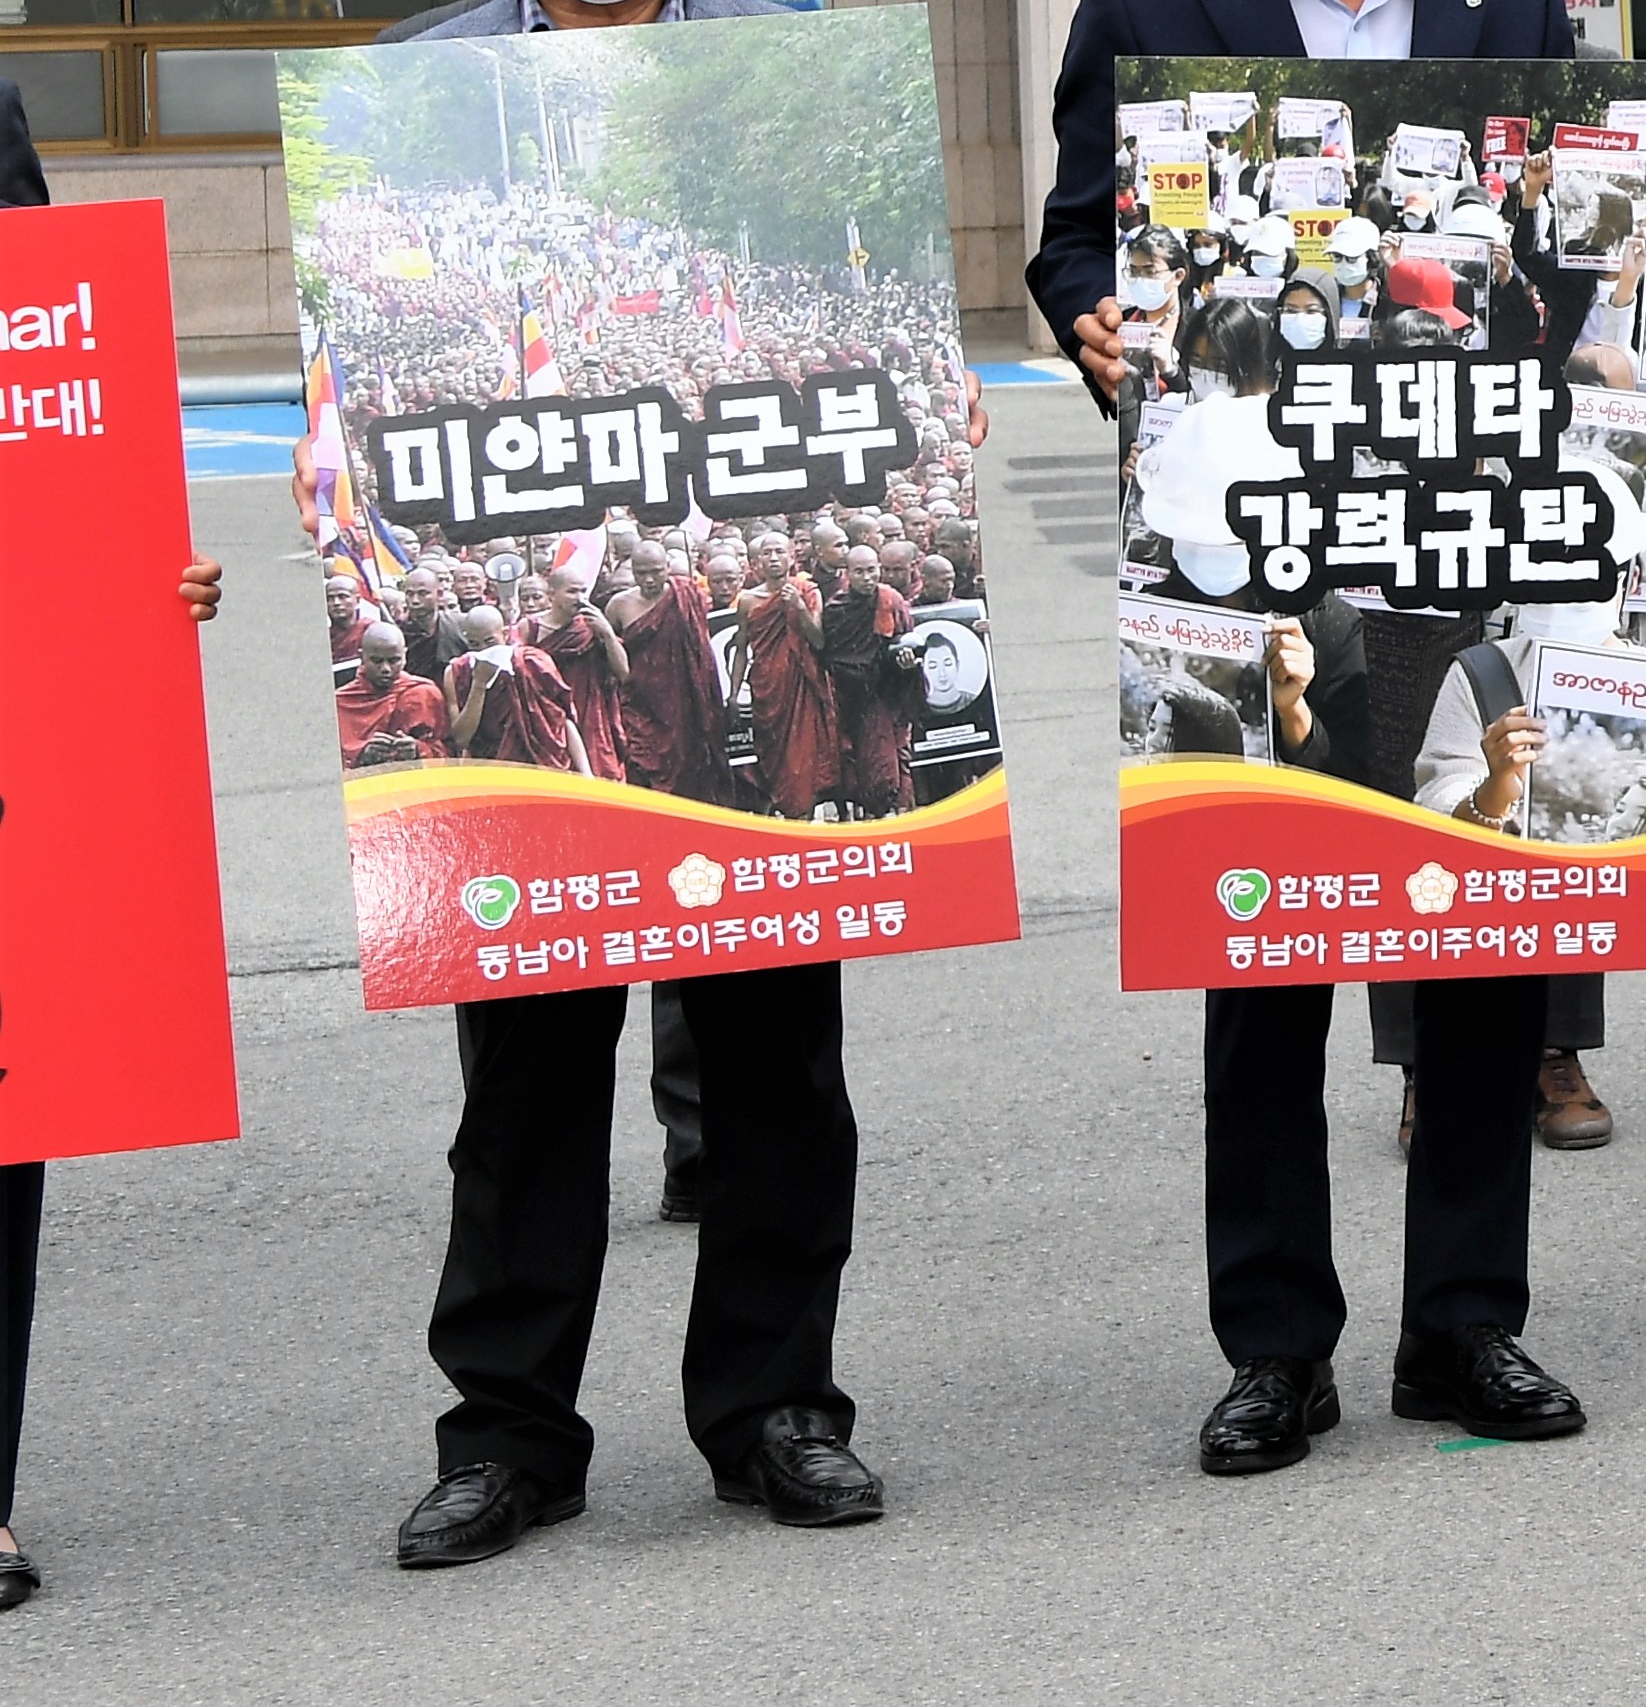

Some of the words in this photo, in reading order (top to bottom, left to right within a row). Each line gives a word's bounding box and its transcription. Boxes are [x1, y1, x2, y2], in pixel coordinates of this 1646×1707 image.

[1153, 172, 1203, 190] STOP
[1281, 359, 1555, 460] 쿠데타
[382, 399, 678, 522] 미얀마
[708, 383, 899, 498] 군부
[1241, 485, 1601, 591] 강력규탄
[527, 869, 641, 915] 함평군
[731, 841, 914, 893] 함평군의회
[1277, 873, 1381, 910] 함평군
[1463, 864, 1627, 903] 함평군의회
[476, 936, 590, 981] 동남아
[602, 909, 820, 966] 결혼이주여성
[835, 900, 907, 940] 일동
[1225, 933, 1329, 970] 동남아
[1341, 924, 1539, 964] 결혼이주여성
[1553, 921, 1617, 955] 일동
